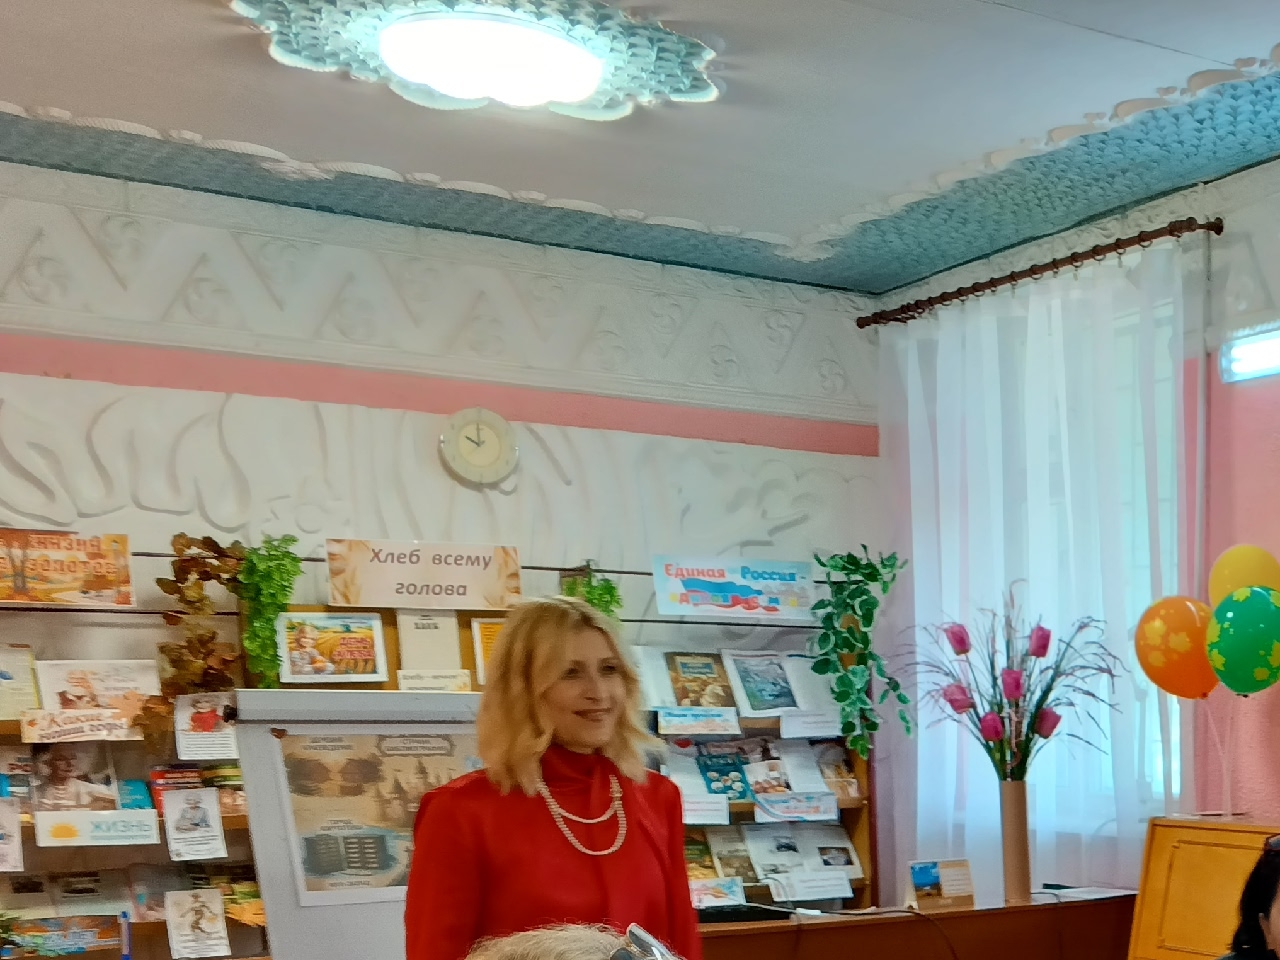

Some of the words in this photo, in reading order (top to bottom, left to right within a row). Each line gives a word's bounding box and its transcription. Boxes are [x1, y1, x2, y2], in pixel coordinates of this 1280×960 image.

[370, 548, 421, 565] Хлеб
[432, 554, 492, 570] всему
[664, 563, 726, 578] Единая
[741, 566, 796, 581] Россия
[396, 582, 467, 596] голова
